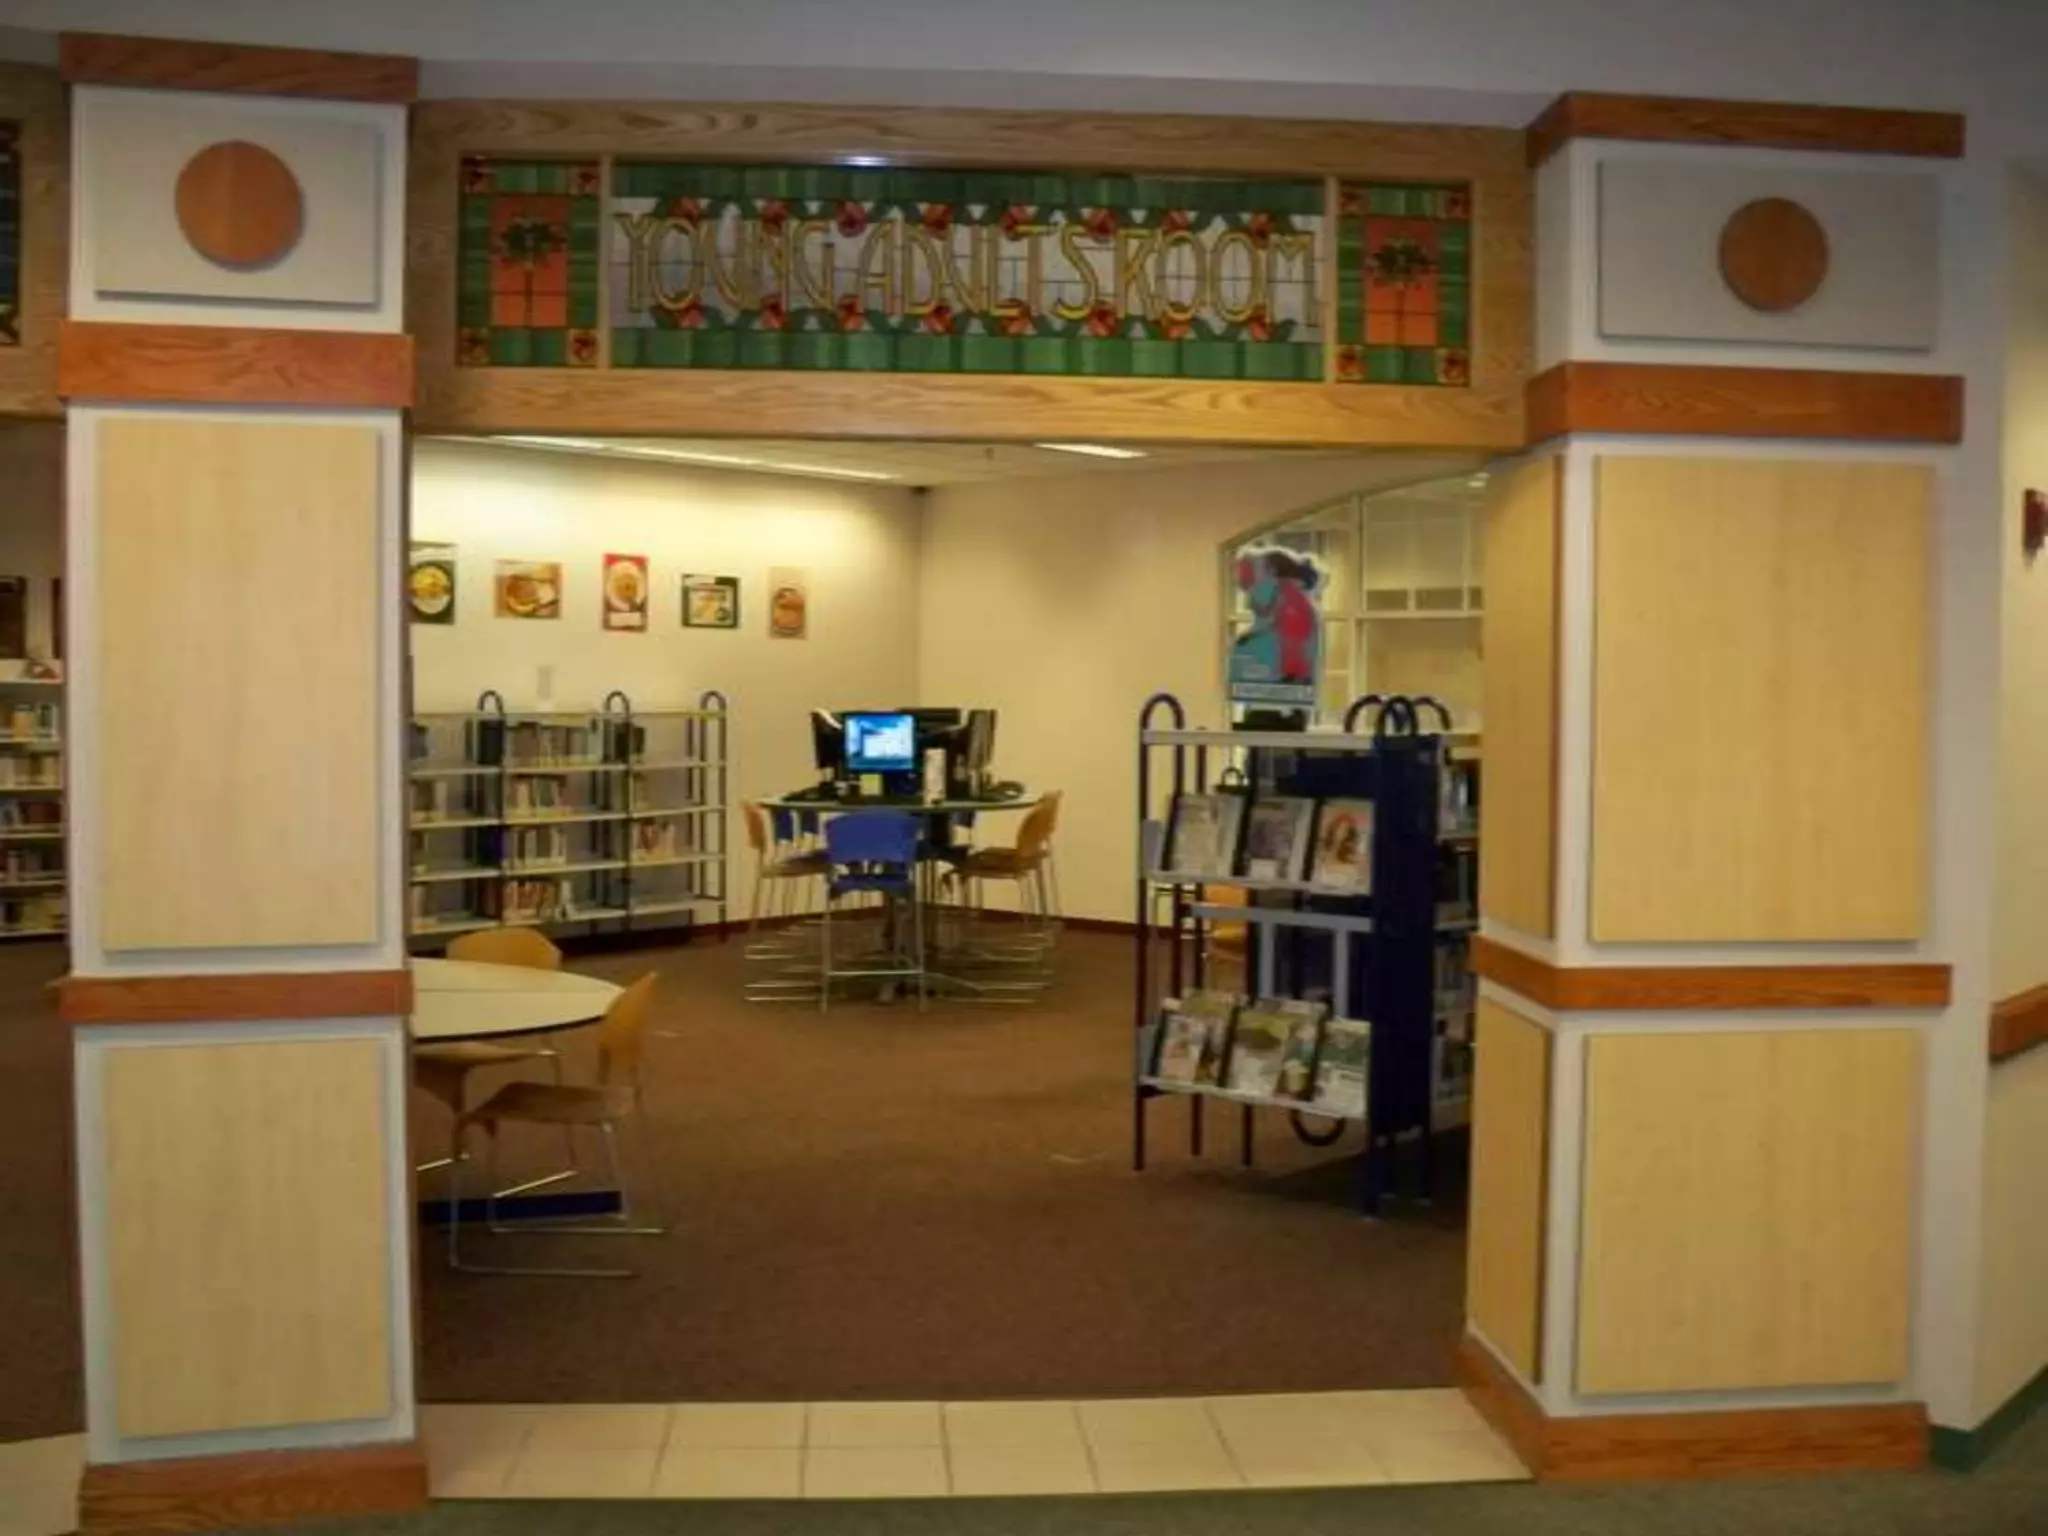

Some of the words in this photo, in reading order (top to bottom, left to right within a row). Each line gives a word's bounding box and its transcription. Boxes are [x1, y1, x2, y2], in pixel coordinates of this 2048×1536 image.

[614, 211, 835, 311] YOUNG
[856, 219, 1099, 319] ADULTS
[1114, 228, 1320, 328] ROOM
